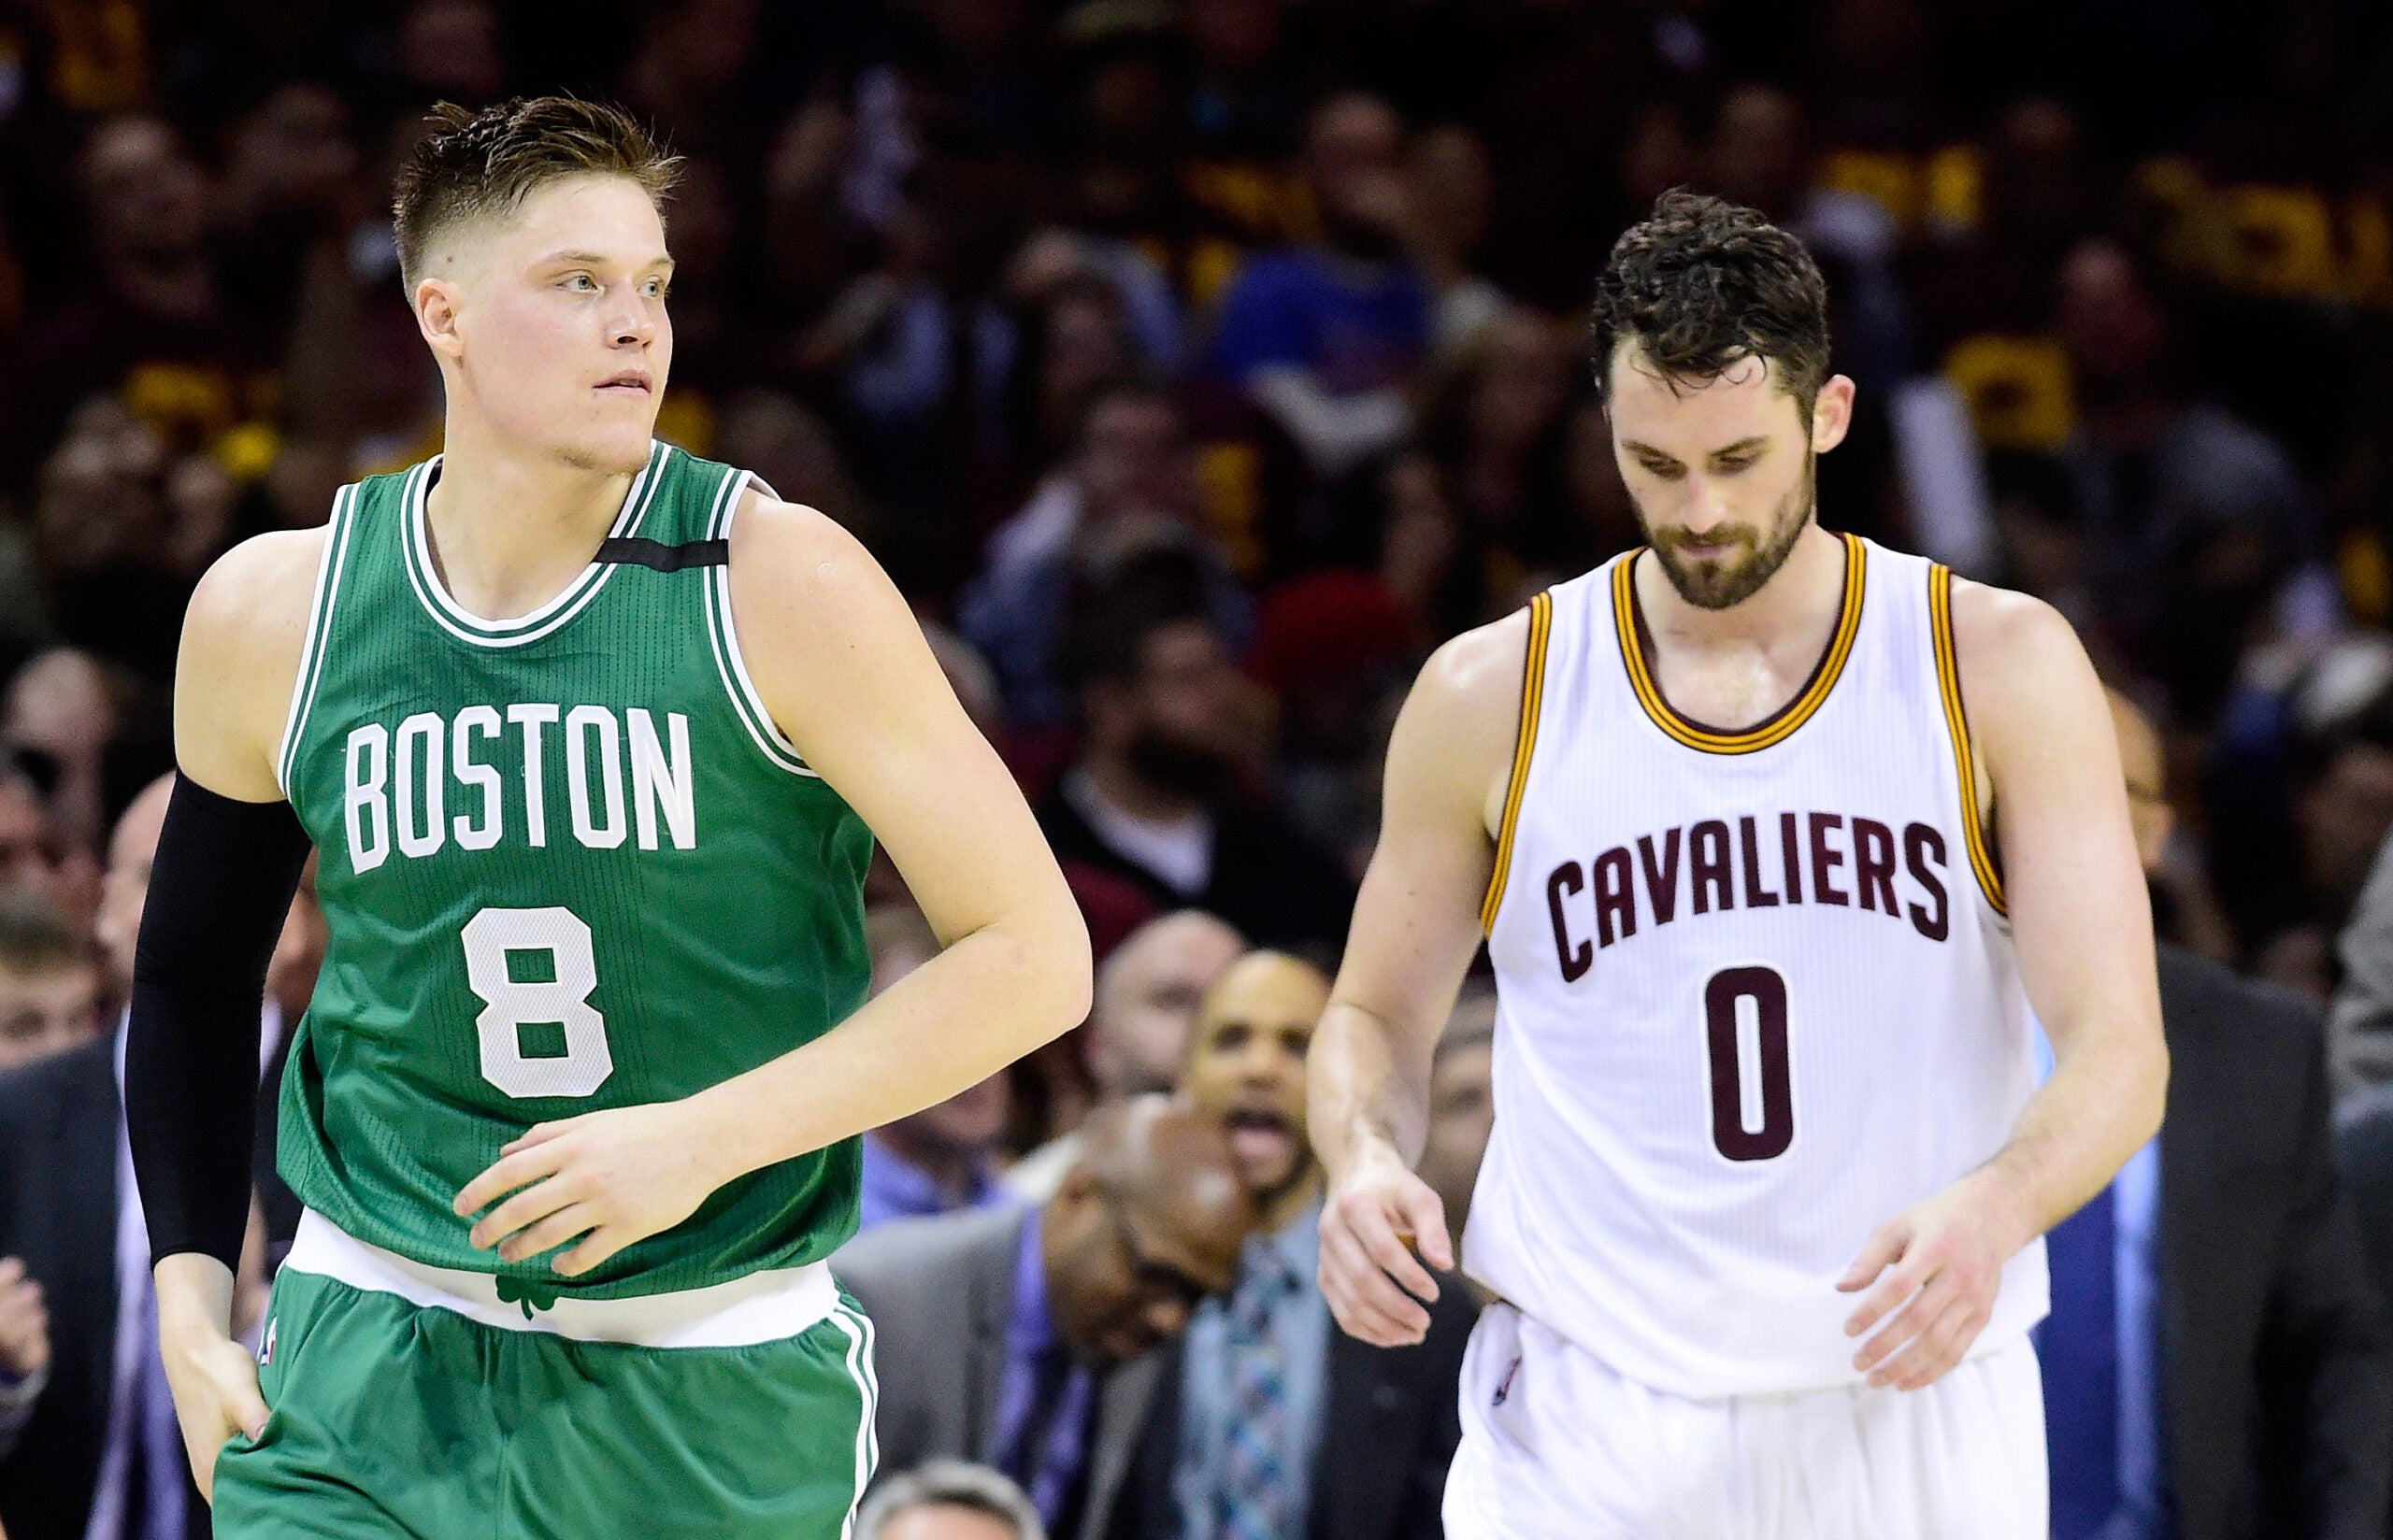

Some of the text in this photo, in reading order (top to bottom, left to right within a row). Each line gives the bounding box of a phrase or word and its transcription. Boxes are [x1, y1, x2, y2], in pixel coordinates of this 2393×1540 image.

[345, 704, 696, 875] BOSTON
[1547, 811, 1949, 983] CAVALIERS
[461, 906, 614, 1098] 8
[1705, 965, 1793, 1162] 0
